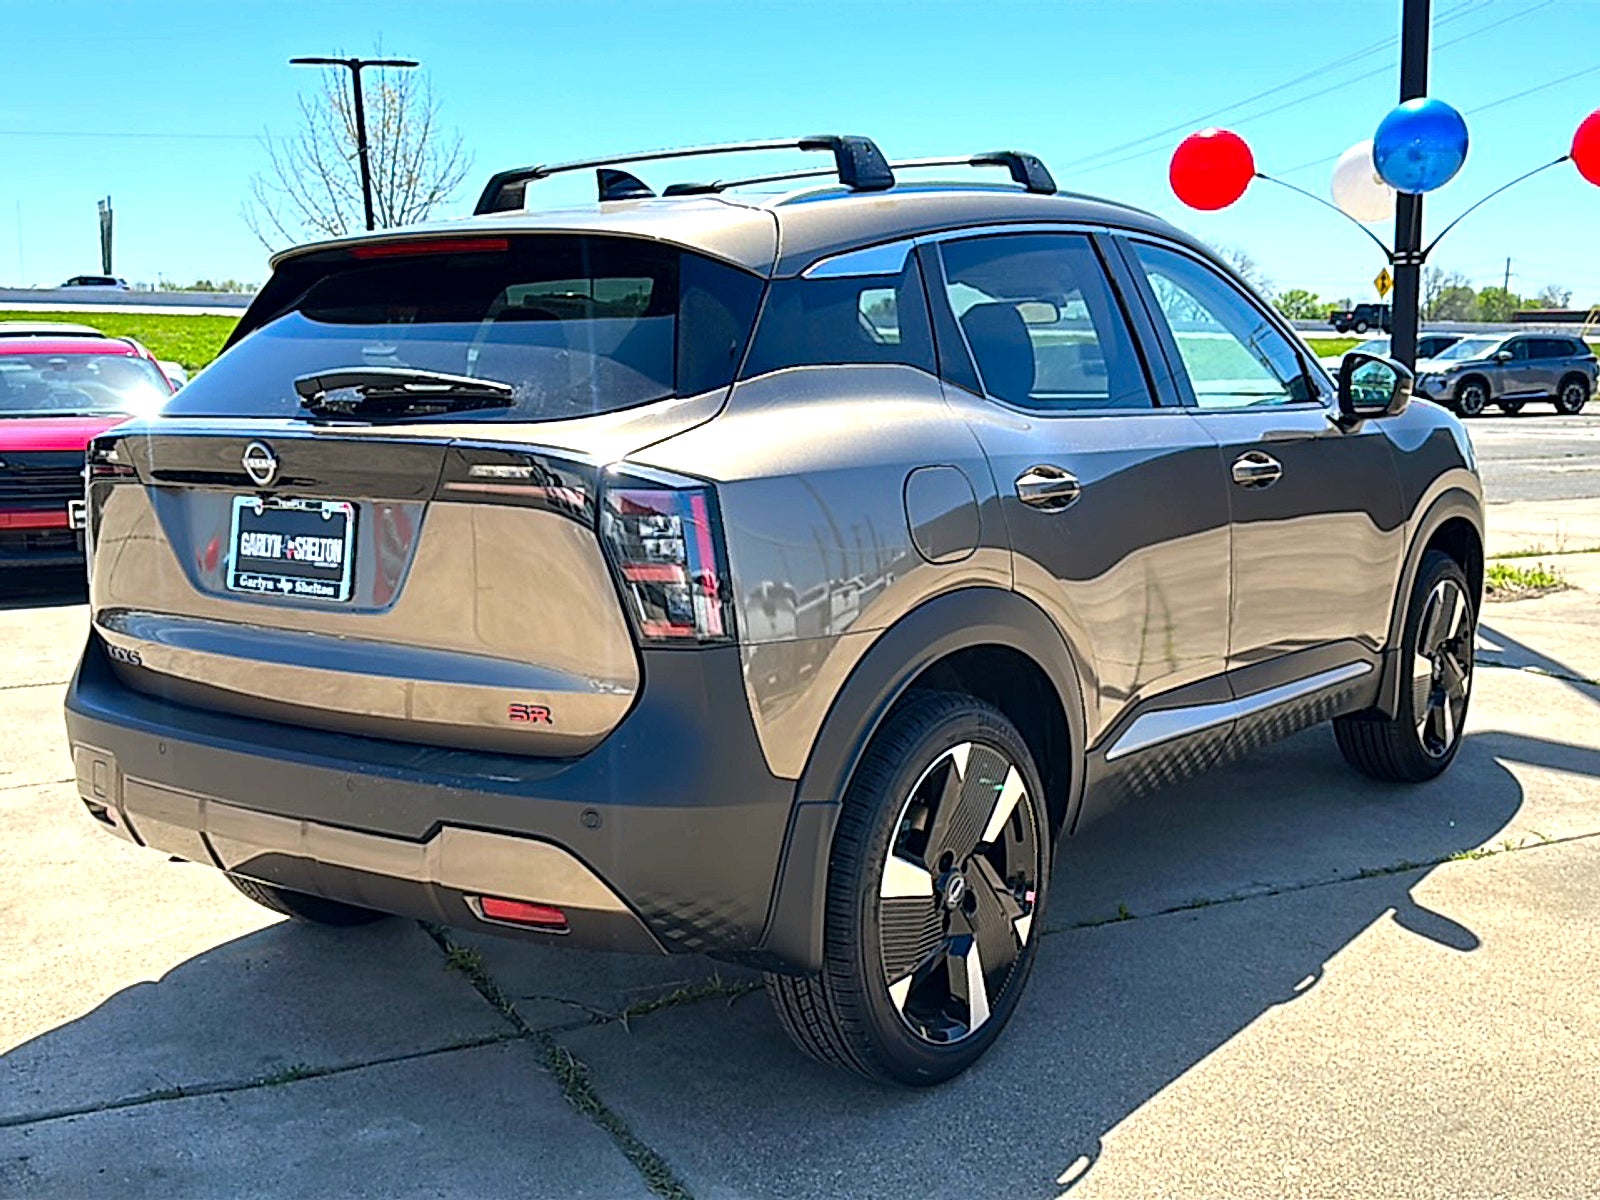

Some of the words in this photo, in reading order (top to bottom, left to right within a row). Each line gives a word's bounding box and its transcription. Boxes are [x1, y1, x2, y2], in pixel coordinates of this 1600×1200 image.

[240, 532, 282, 558] GARLYN
[294, 536, 343, 563] SHELTON
[295, 581, 335, 596] Shelton
[508, 703, 553, 725] SR
